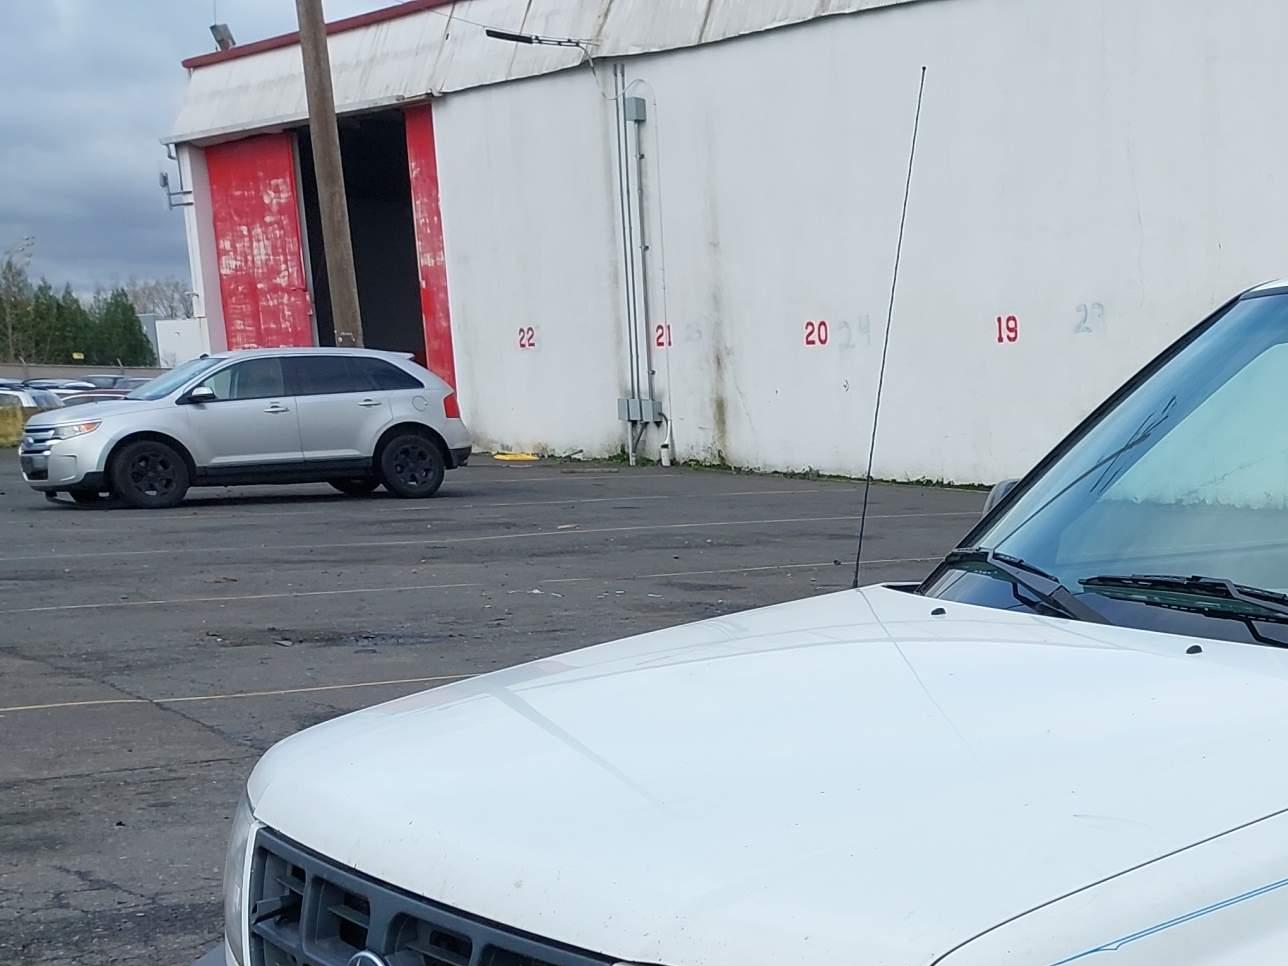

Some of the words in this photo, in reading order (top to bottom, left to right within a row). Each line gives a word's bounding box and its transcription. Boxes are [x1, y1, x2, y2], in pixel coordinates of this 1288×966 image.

[518, 326, 536, 348] 22
[655, 324, 673, 347] 21
[804, 320, 828, 345] 20
[997, 315, 1018, 343] 19
